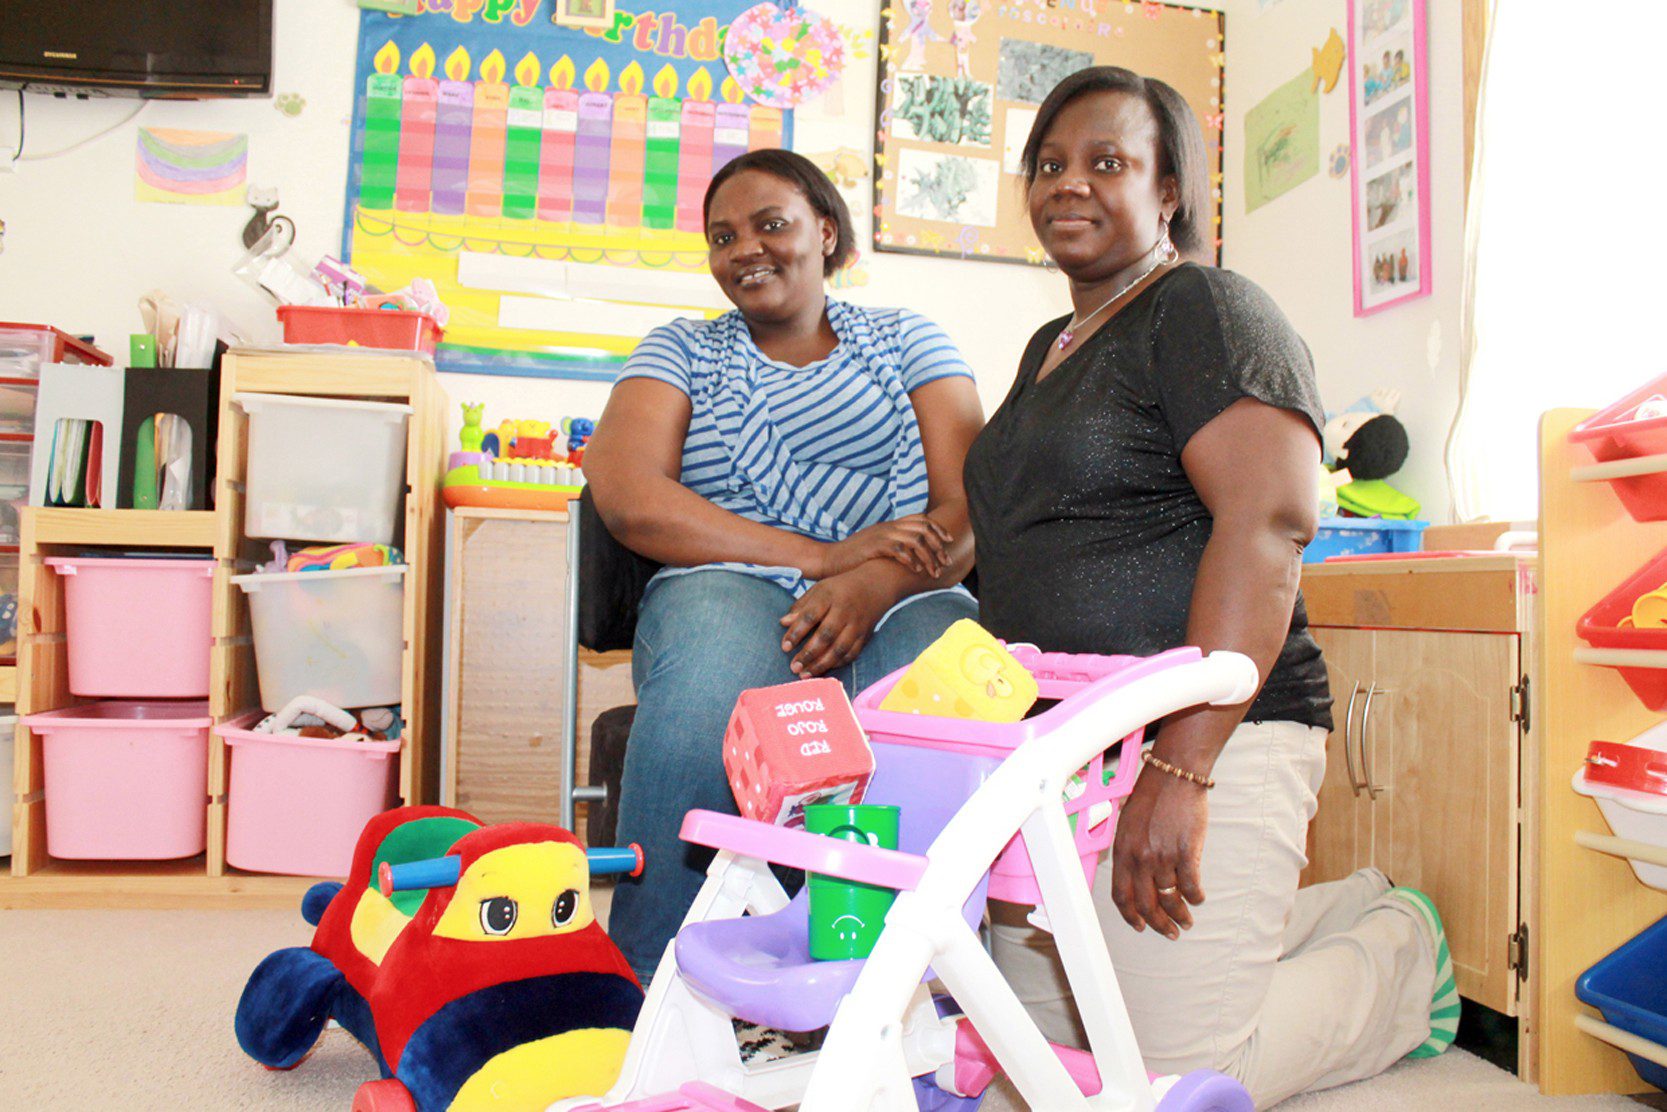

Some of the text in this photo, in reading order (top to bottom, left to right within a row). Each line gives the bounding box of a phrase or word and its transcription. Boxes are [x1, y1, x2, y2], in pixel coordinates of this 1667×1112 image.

[552, 11, 731, 60] rthd
[775, 698, 825, 717] ROUGE
[787, 719, 829, 736] ROJO
[800, 739, 832, 756] RED
